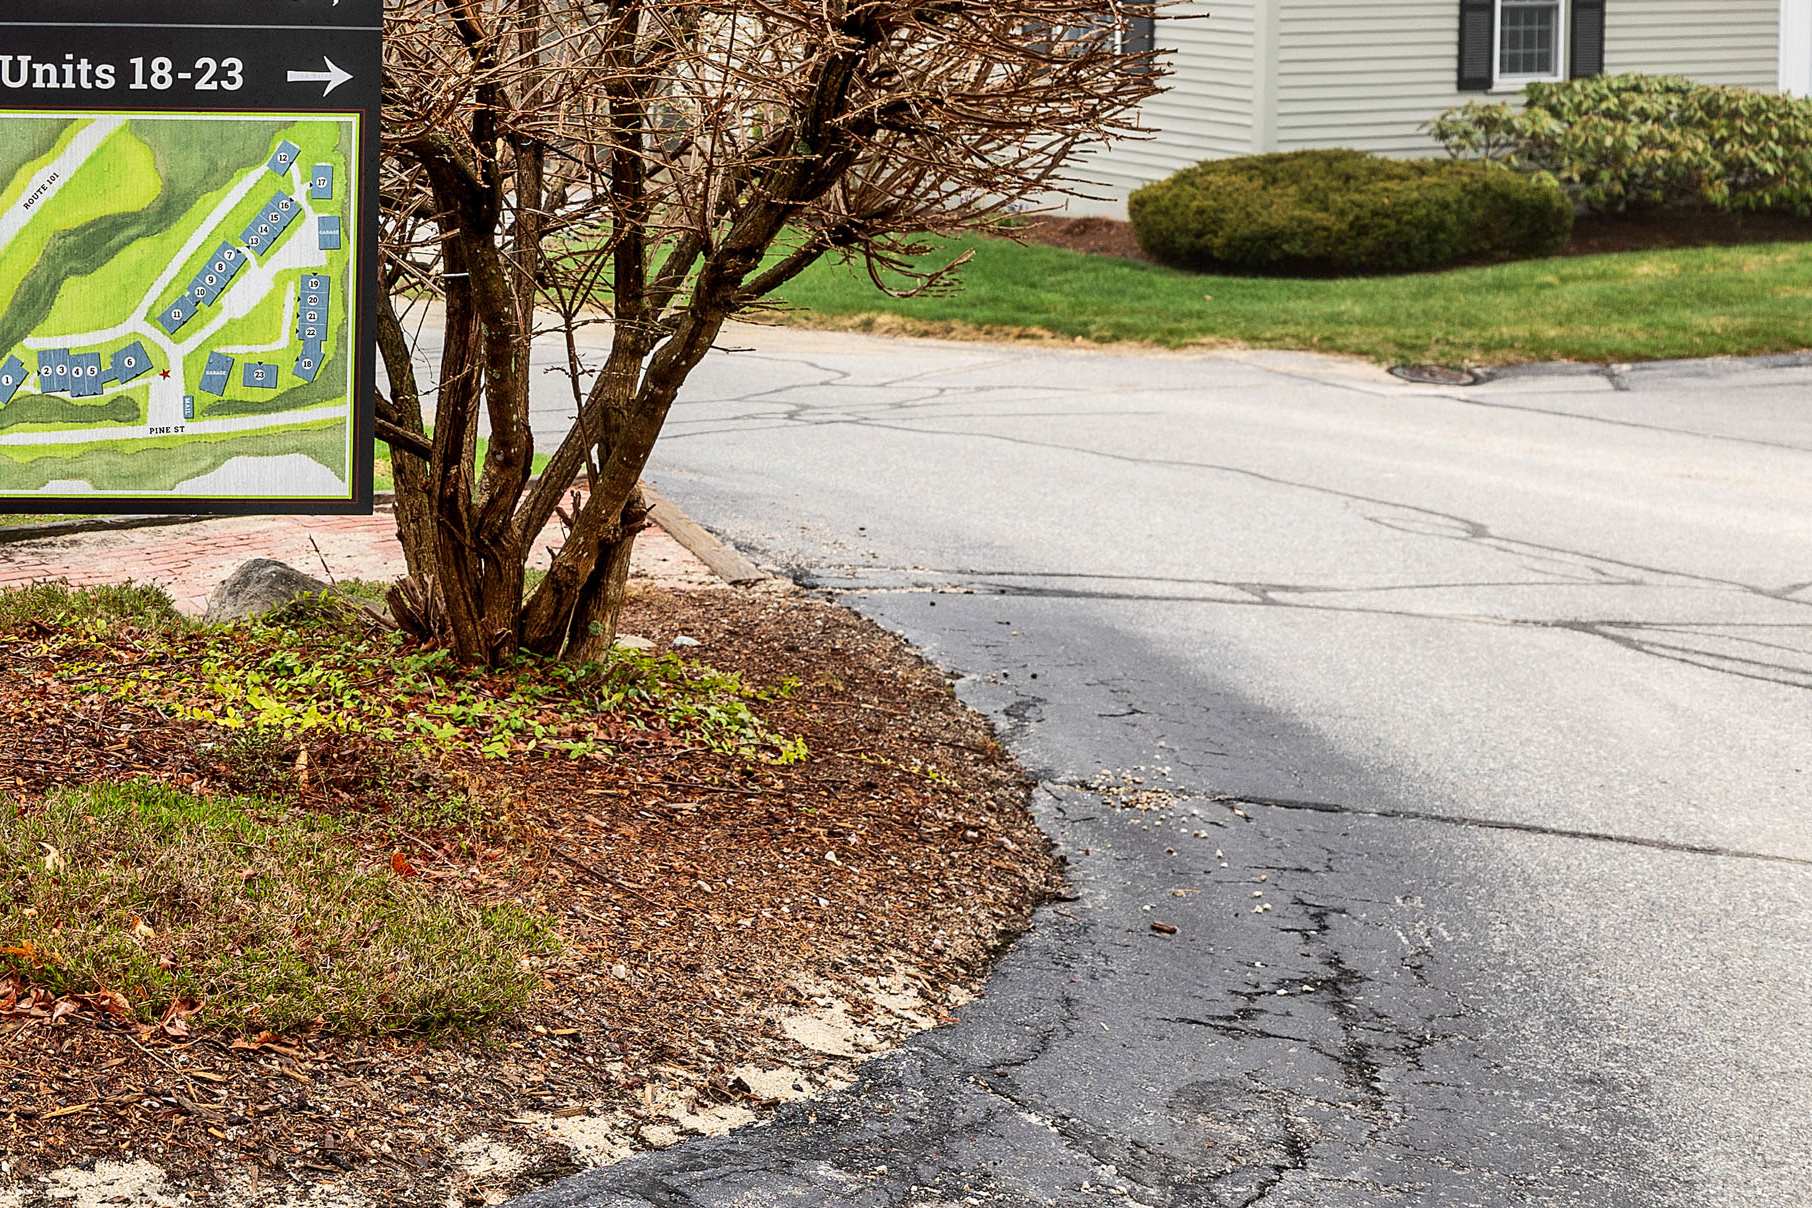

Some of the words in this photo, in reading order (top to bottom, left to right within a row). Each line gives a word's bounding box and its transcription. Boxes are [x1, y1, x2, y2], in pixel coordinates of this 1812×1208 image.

[128, 56, 244, 91] 18-23
[279, 154, 287, 162] 12
[22, 184, 48, 210] ROUTE
[46, 172, 59, 185] 101
[196, 288, 205, 296] 10
[308, 296, 318, 304] 20
[303, 360, 312, 368] 18
[149, 426, 171, 435] PINE
